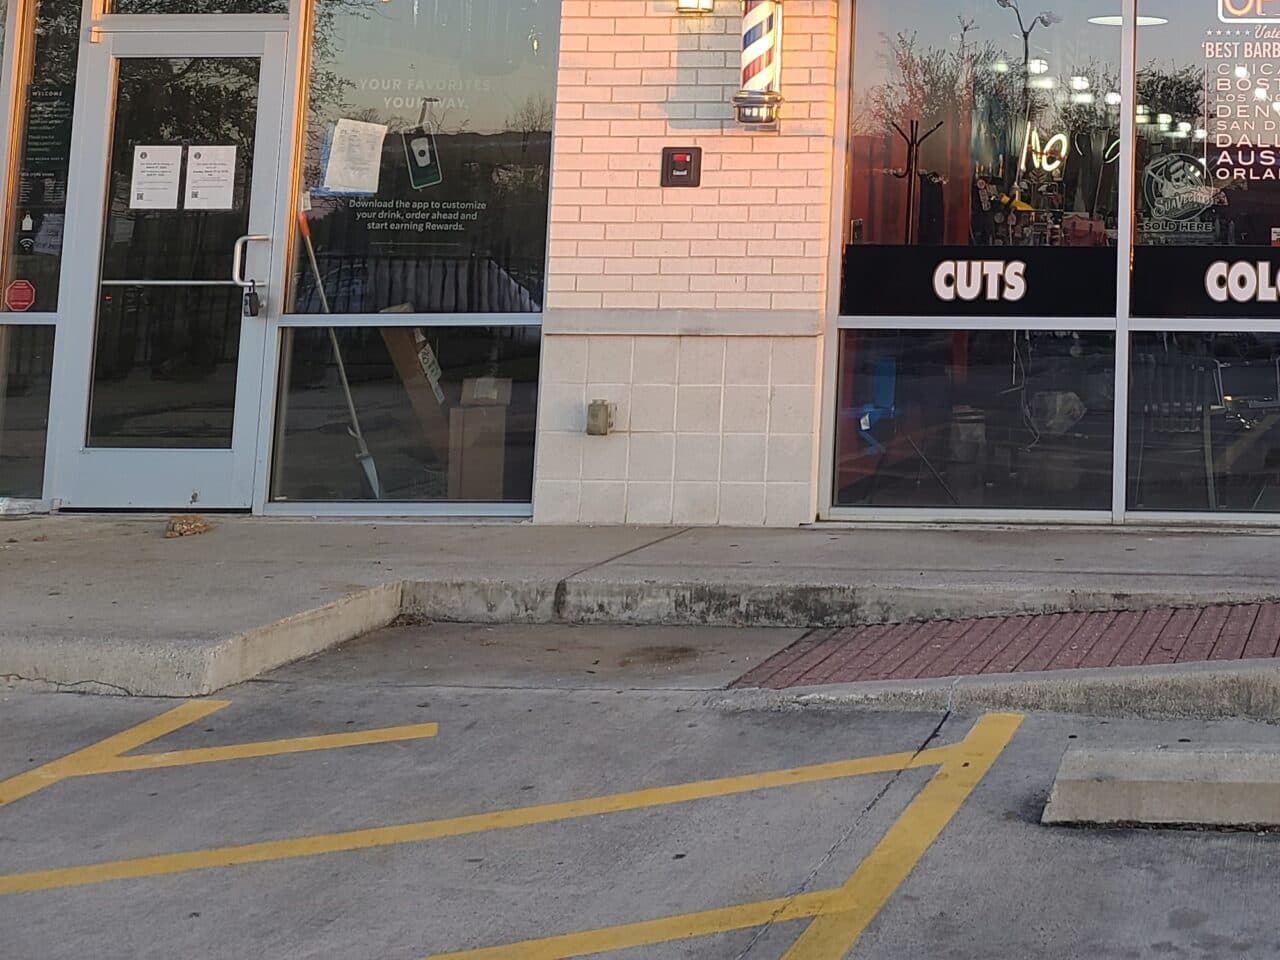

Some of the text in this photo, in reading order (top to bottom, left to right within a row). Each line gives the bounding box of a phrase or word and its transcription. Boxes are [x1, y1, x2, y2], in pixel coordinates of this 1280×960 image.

[360, 79, 401, 90] YOUR
[1217, 93, 1246, 102] LOS
[1217, 120, 1255, 131] SAN
[349, 200, 487, 210] Download the app to customize
[356, 212, 376, 220] your
[405, 211, 430, 220] order
[432, 211, 459, 220] ahead
[460, 211, 478, 220] and
[367, 221, 465, 232] start earning Rewards.
[1145, 221, 1212, 232] SOLD HERE
[932, 259, 1027, 303] CUTS
